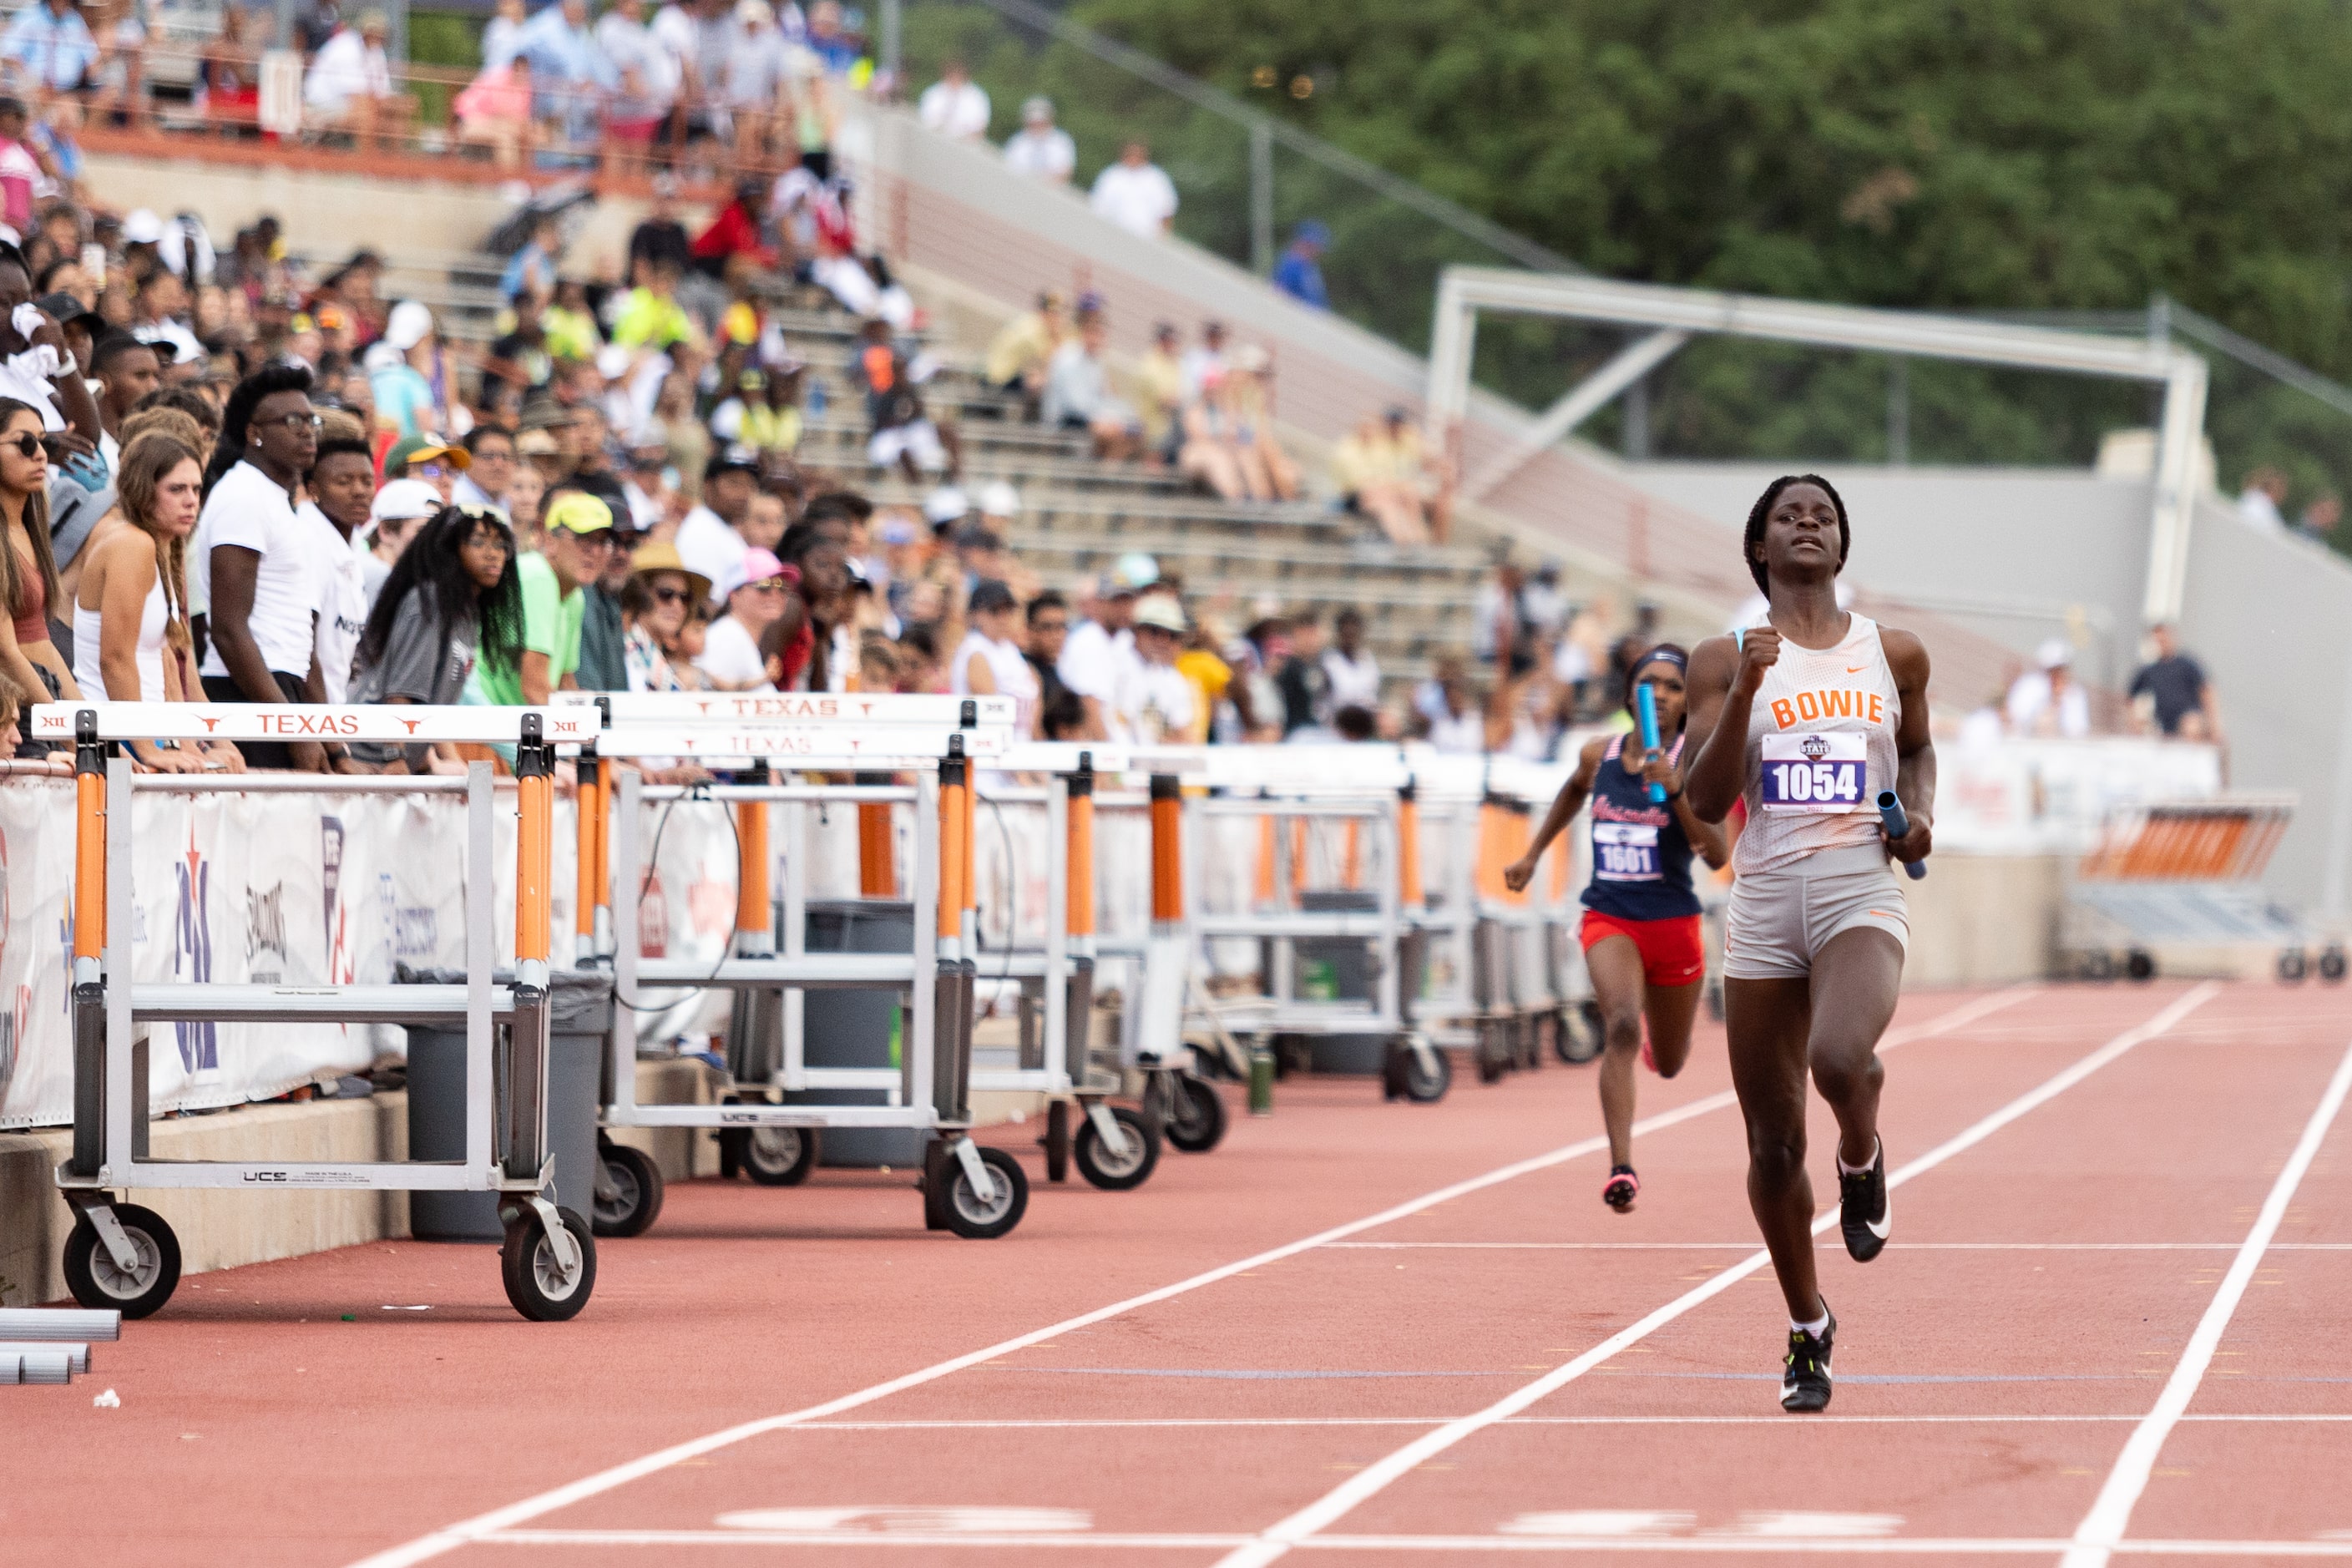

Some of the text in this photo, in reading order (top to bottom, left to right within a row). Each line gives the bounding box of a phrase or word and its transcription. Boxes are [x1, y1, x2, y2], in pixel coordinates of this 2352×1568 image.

[732, 699, 838, 717] TEXAS
[1770, 690, 1883, 730] BOWIE
[40, 716, 67, 728] XII
[256, 714, 359, 735] TEXAS
[553, 721, 579, 733] XII
[731, 736, 812, 755] TEXAS
[1799, 745, 1831, 753] STATE
[1773, 763, 1859, 801] 1054
[1601, 845, 1651, 873] 1601
[244, 1171, 287, 1181] UCS
